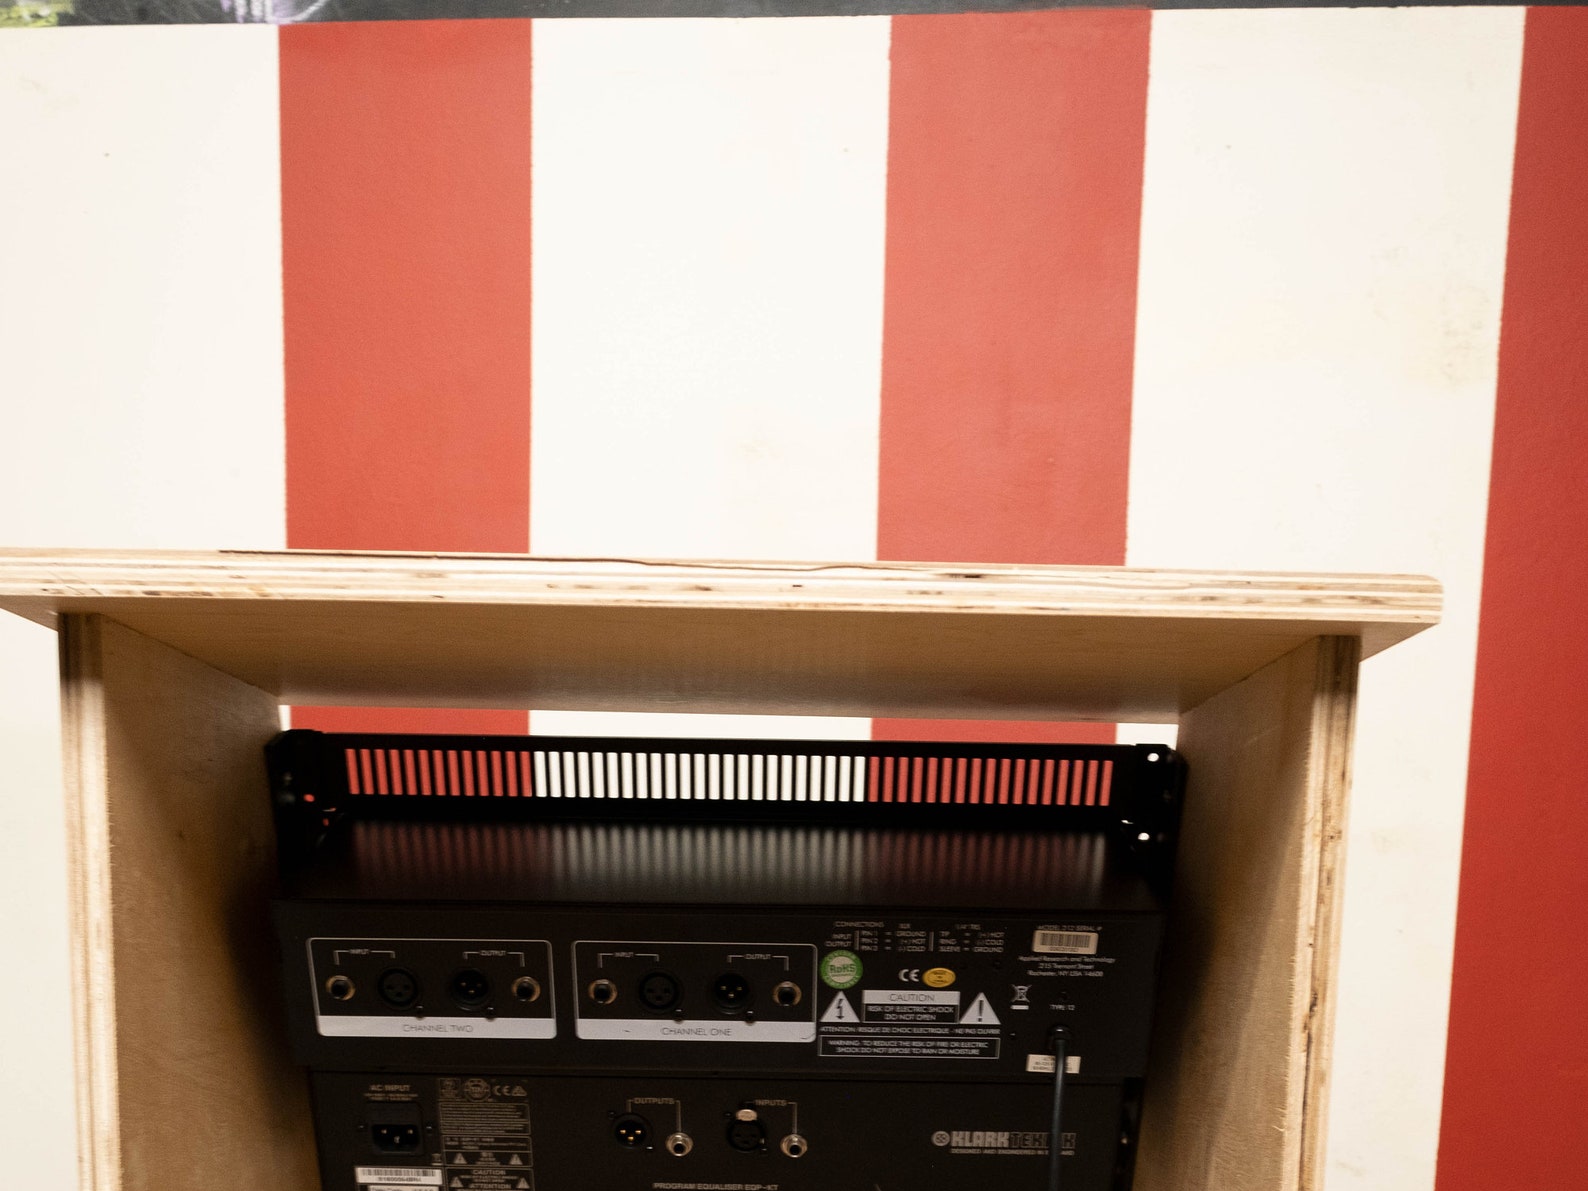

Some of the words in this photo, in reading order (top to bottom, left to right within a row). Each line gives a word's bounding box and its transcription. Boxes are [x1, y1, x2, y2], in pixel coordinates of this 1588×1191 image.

[830, 964, 856, 974] RoHS
[889, 993, 935, 1002] CAUTION
[403, 1023, 448, 1033] CHANNEL
[450, 1024, 474, 1033] TWO
[660, 1027, 708, 1036] CHANNEL
[710, 1028, 732, 1037] ONE
[634, 1097, 675, 1105] OUTPUTS
[950, 1131, 1009, 1148] KLARK
[1010, 1131, 1077, 1149] TEKK
[653, 1183, 695, 1191] PROGRAM
